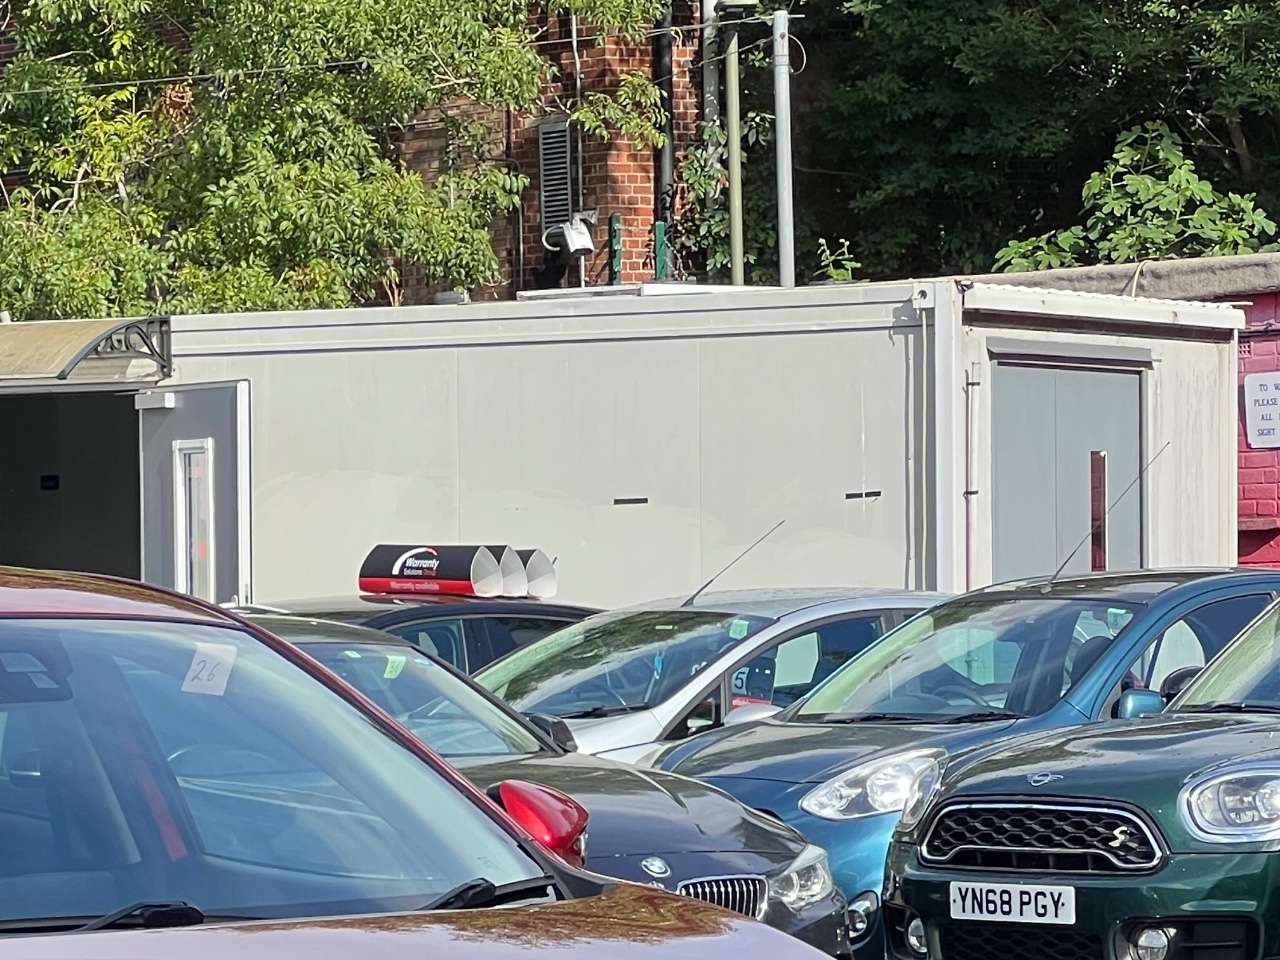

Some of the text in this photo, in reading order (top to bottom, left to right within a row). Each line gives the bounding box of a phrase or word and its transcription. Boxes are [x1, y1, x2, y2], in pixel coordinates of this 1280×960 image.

[1259, 383, 1268, 392] TO
[1254, 398, 1278, 407] PLEASE
[1261, 413, 1272, 421] ALL
[1257, 428, 1275, 436] SIGHT
[405, 557, 440, 570] Warranty
[191, 660, 222, 681] 26
[958, 887, 1063, 918] YN68 PGY
